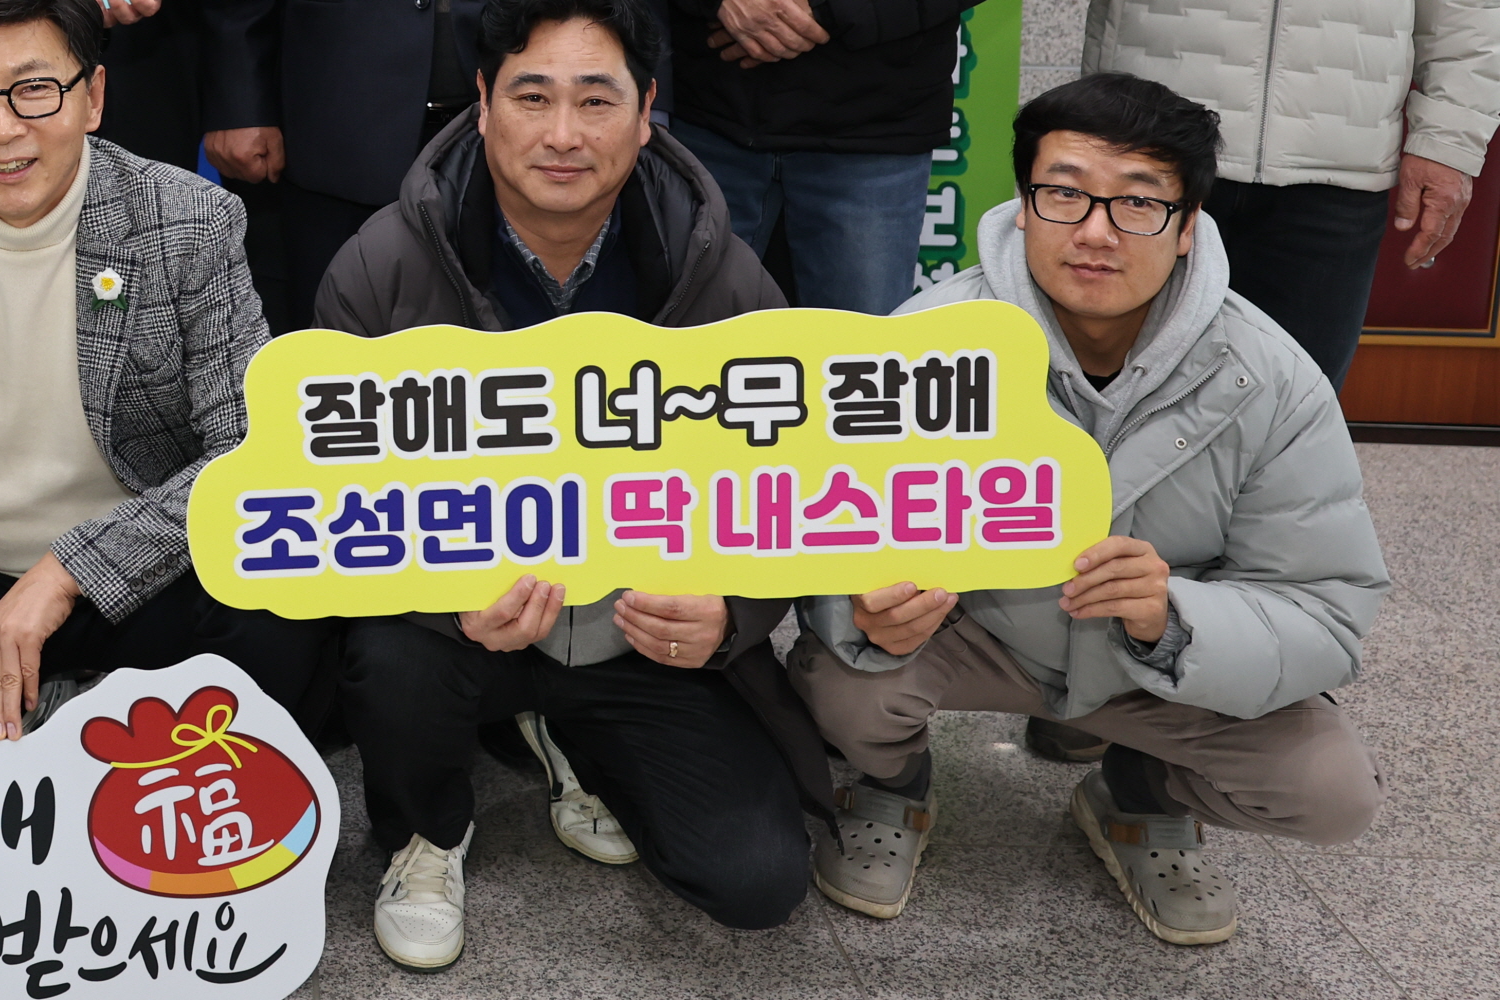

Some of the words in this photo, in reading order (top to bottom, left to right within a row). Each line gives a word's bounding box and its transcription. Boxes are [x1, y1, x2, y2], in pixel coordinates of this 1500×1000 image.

[303, 371, 553, 461] 잘해도
[574, 356, 806, 451] 너~무
[830, 354, 991, 437] 잘해
[241, 480, 581, 571] 조성면이
[611, 474, 692, 553] 딱
[715, 464, 1056, 551] 내스타일
[134, 763, 275, 867] 福
